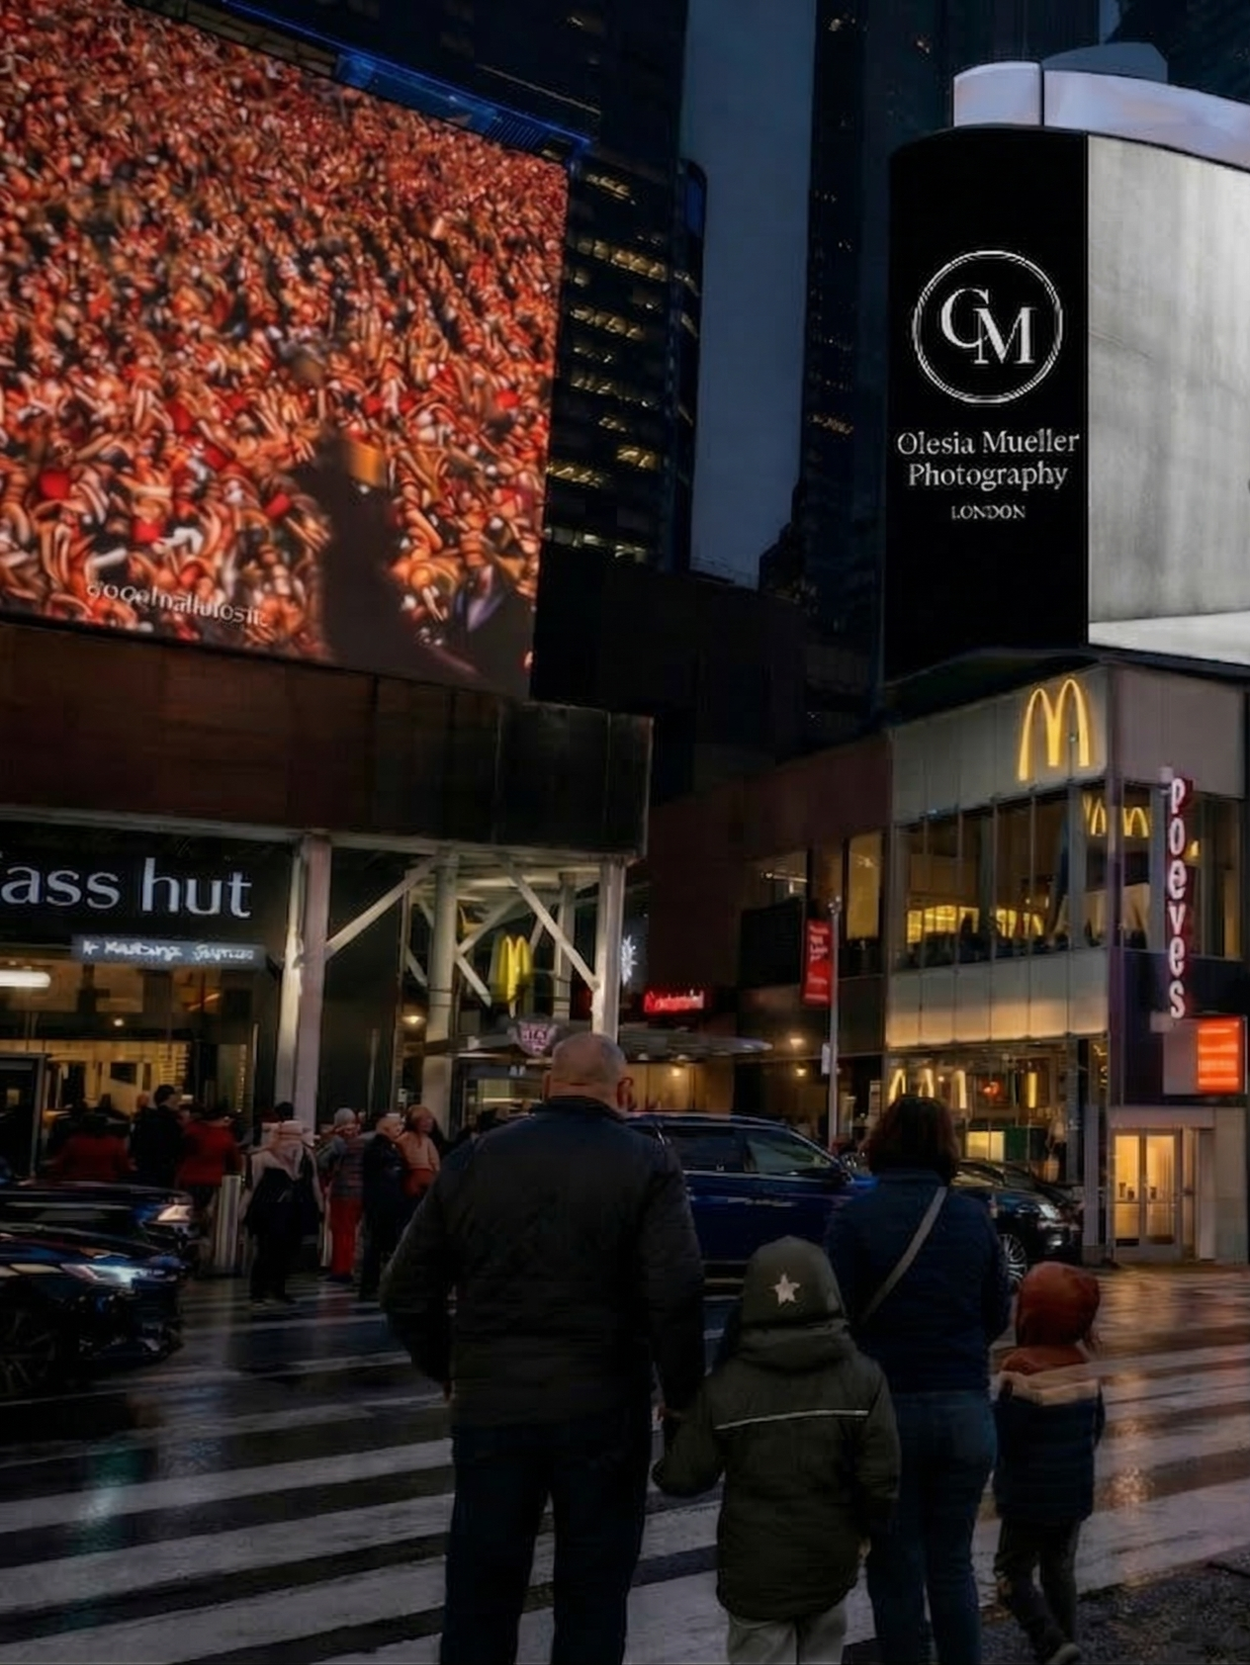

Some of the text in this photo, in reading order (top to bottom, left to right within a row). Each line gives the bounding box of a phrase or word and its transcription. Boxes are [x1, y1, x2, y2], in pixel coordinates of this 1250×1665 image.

[897, 428, 1081, 455] Olesia Mueller
[909, 460, 1069, 492] Photography
[950, 504, 1027, 520] LONDON
[142, 857, 252, 918] hut
